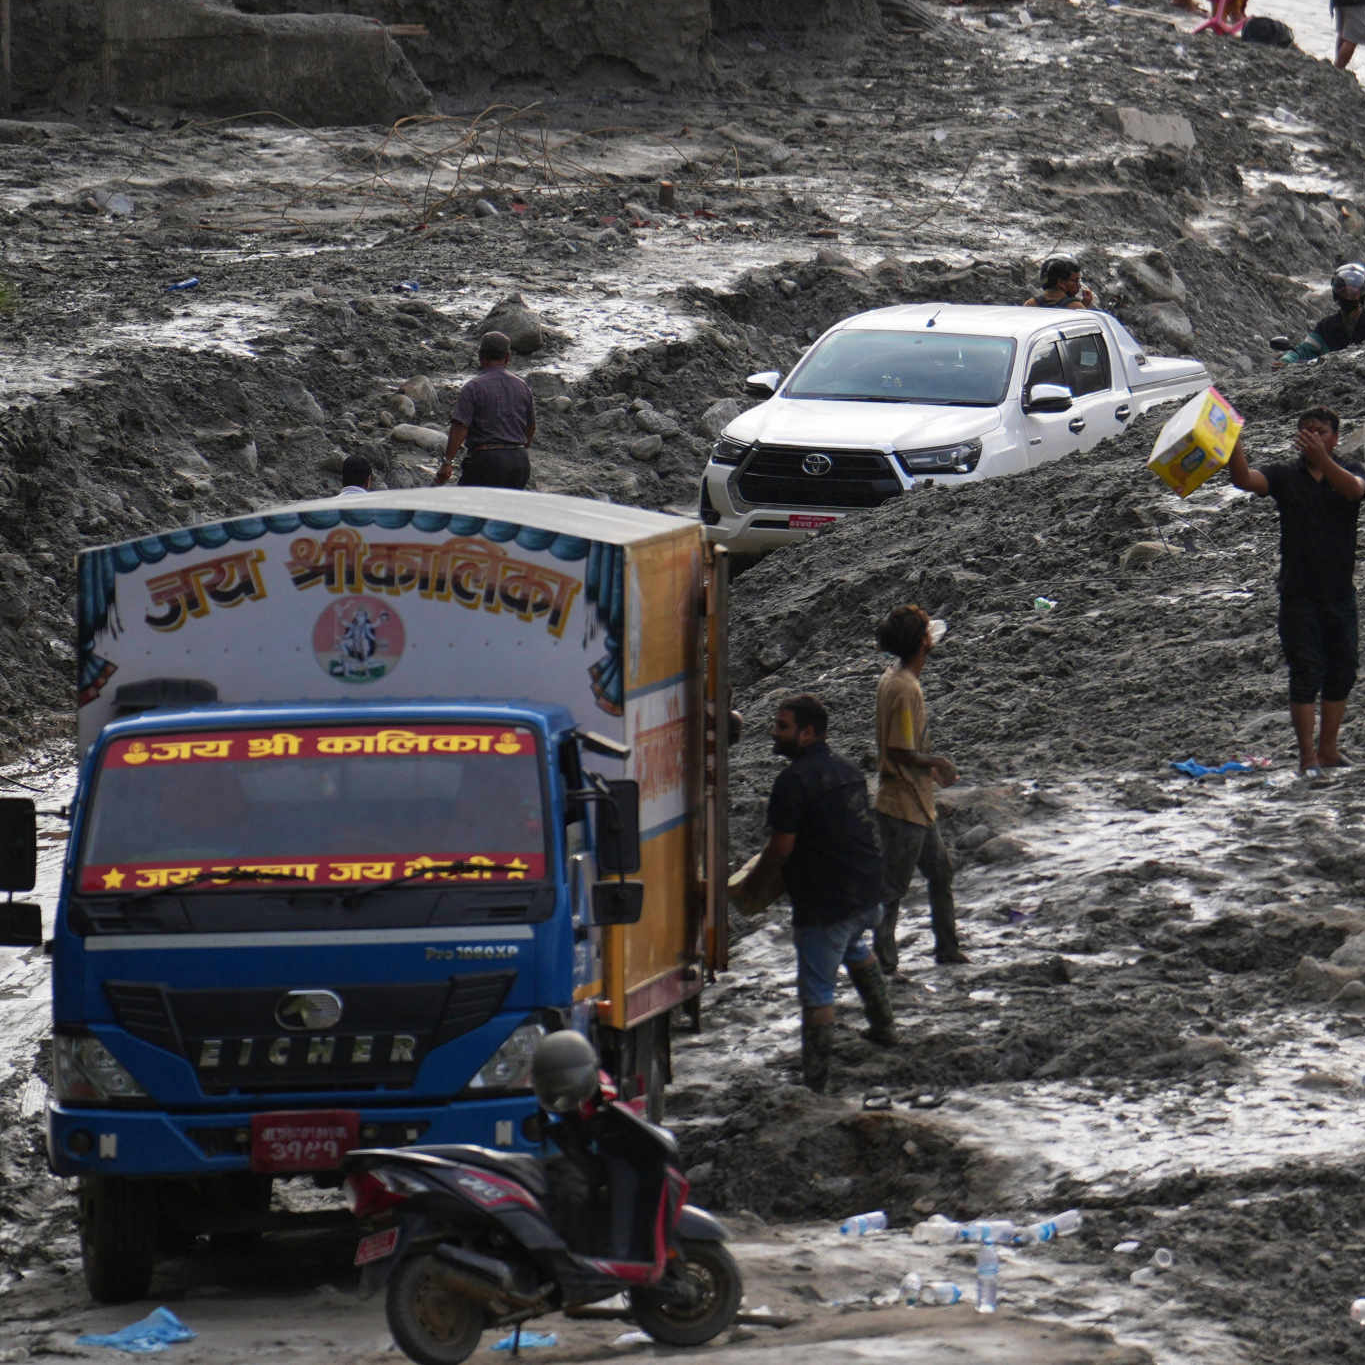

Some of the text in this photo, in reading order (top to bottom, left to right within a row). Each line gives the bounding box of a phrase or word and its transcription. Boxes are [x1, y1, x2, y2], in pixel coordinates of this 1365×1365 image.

[145, 548, 268, 633] जय
[151, 730, 494, 761] जय श्री कालिका
[136, 867, 203, 888] जय
[329, 862, 395, 882] जय
[425, 947, 454, 960] Pro
[199, 1035, 419, 1068] EICHER
